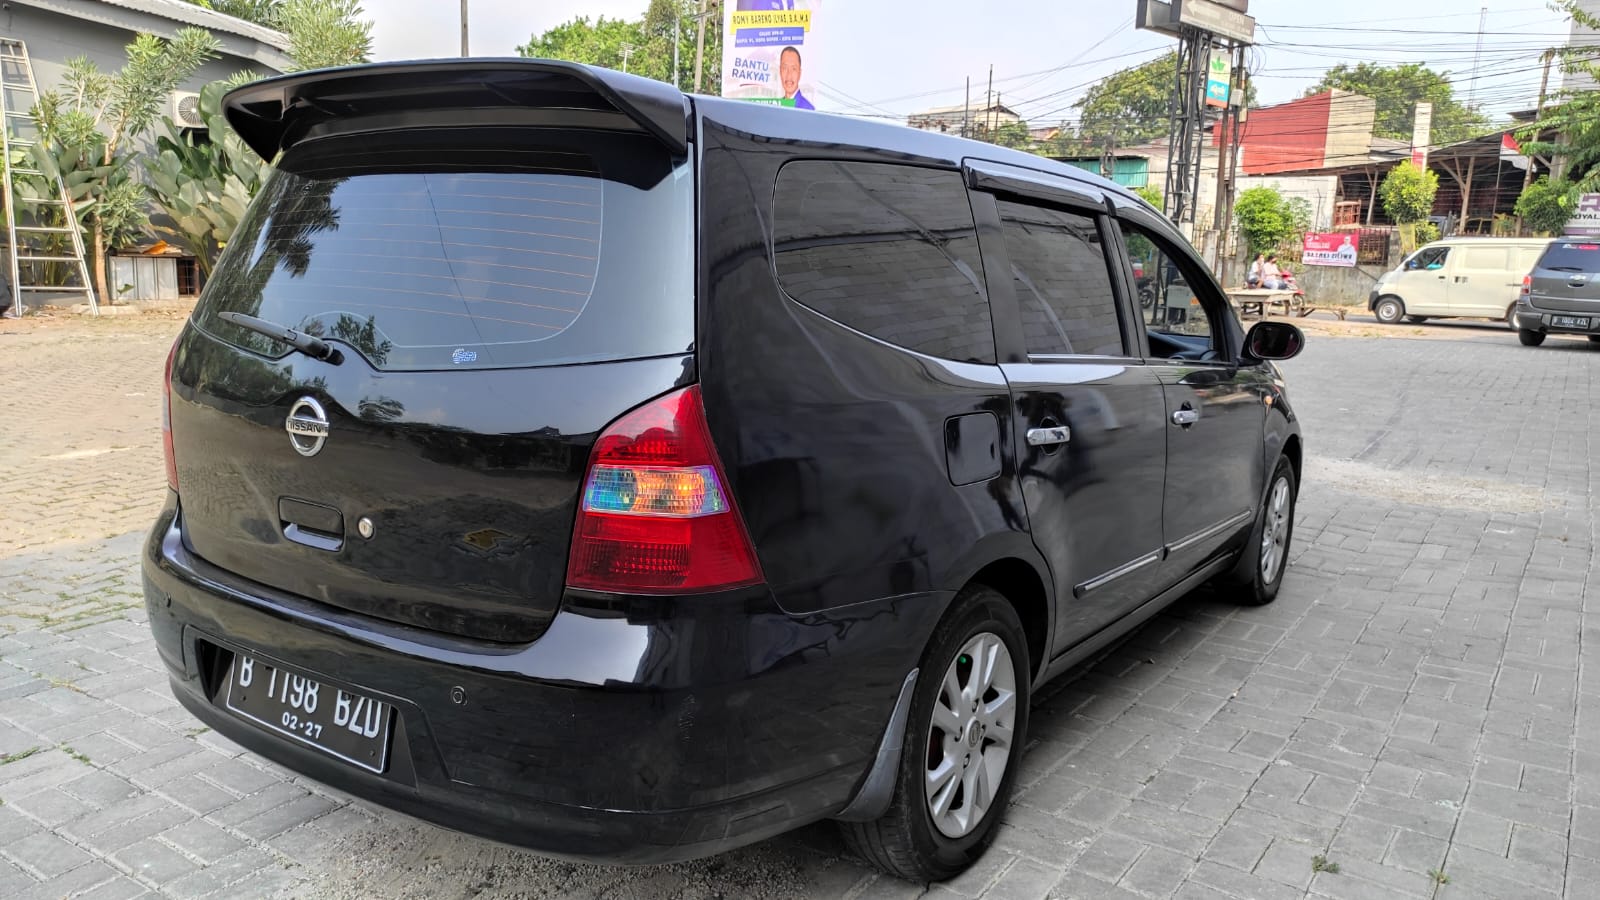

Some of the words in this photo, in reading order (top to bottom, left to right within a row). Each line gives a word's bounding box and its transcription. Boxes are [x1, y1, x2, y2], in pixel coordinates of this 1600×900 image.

[733, 15, 749, 25] ROMY
[734, 57, 769, 71] BANTU
[731, 68, 770, 82] RAKYAT
[287, 420, 322, 433] NISSAN
[239, 656, 254, 687] B
[267, 668, 320, 714] 1198
[333, 689, 382, 739] BZD
